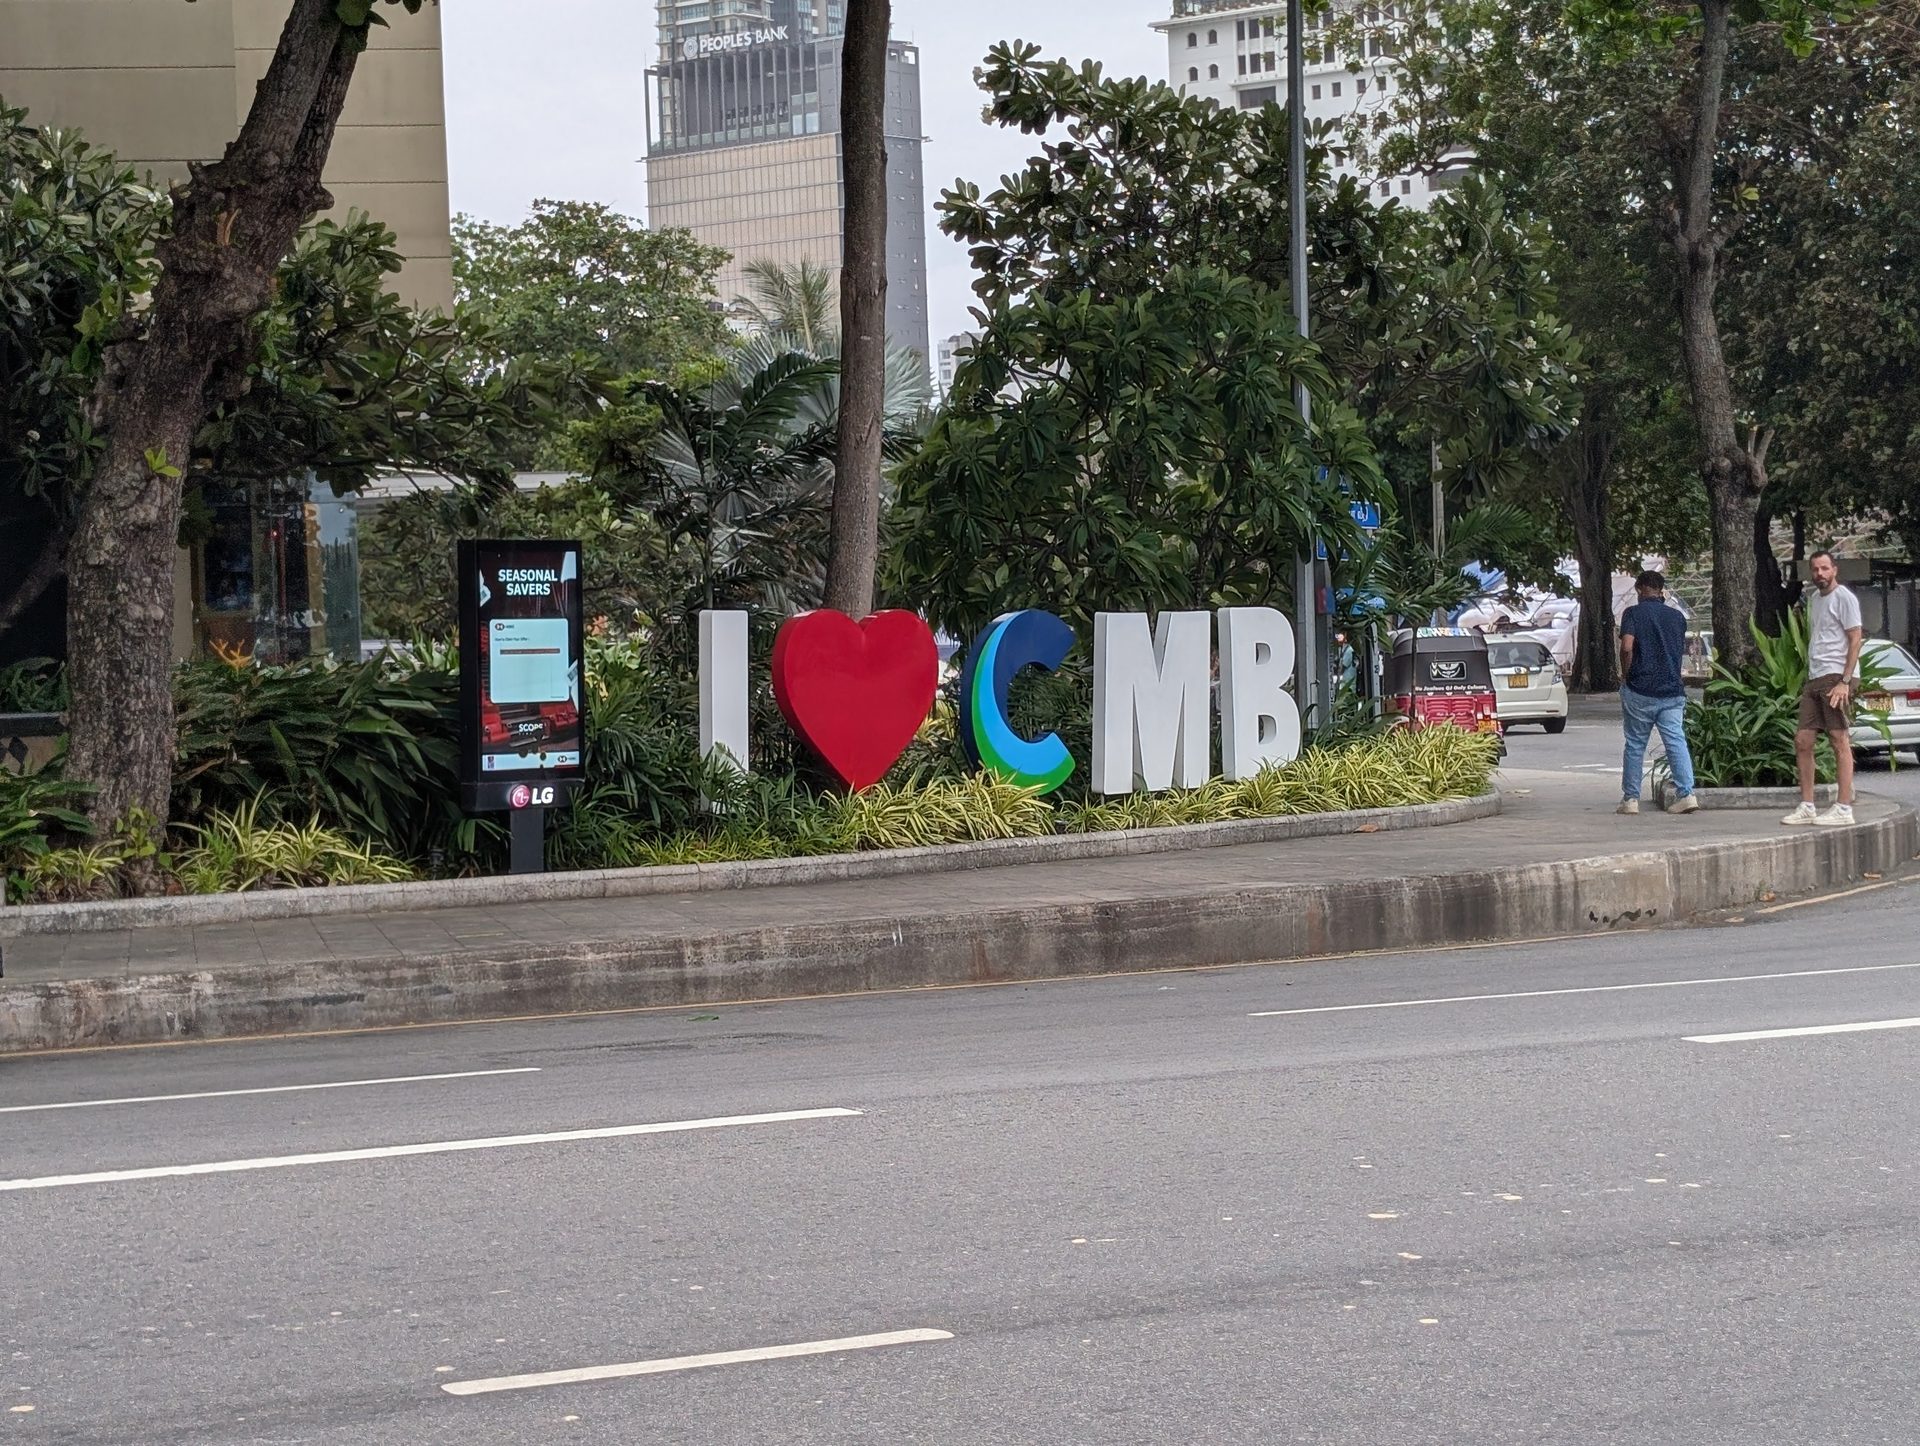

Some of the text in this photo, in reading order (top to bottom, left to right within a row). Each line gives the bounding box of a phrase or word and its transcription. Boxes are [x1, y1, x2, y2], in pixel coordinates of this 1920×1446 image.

[755, 25, 789, 44] BANK
[498, 568, 558, 583] SEASONAL
[506, 583, 551, 596] SAVERS
[698, 607, 1301, 811] I CMB
[531, 786, 554, 805] LG
